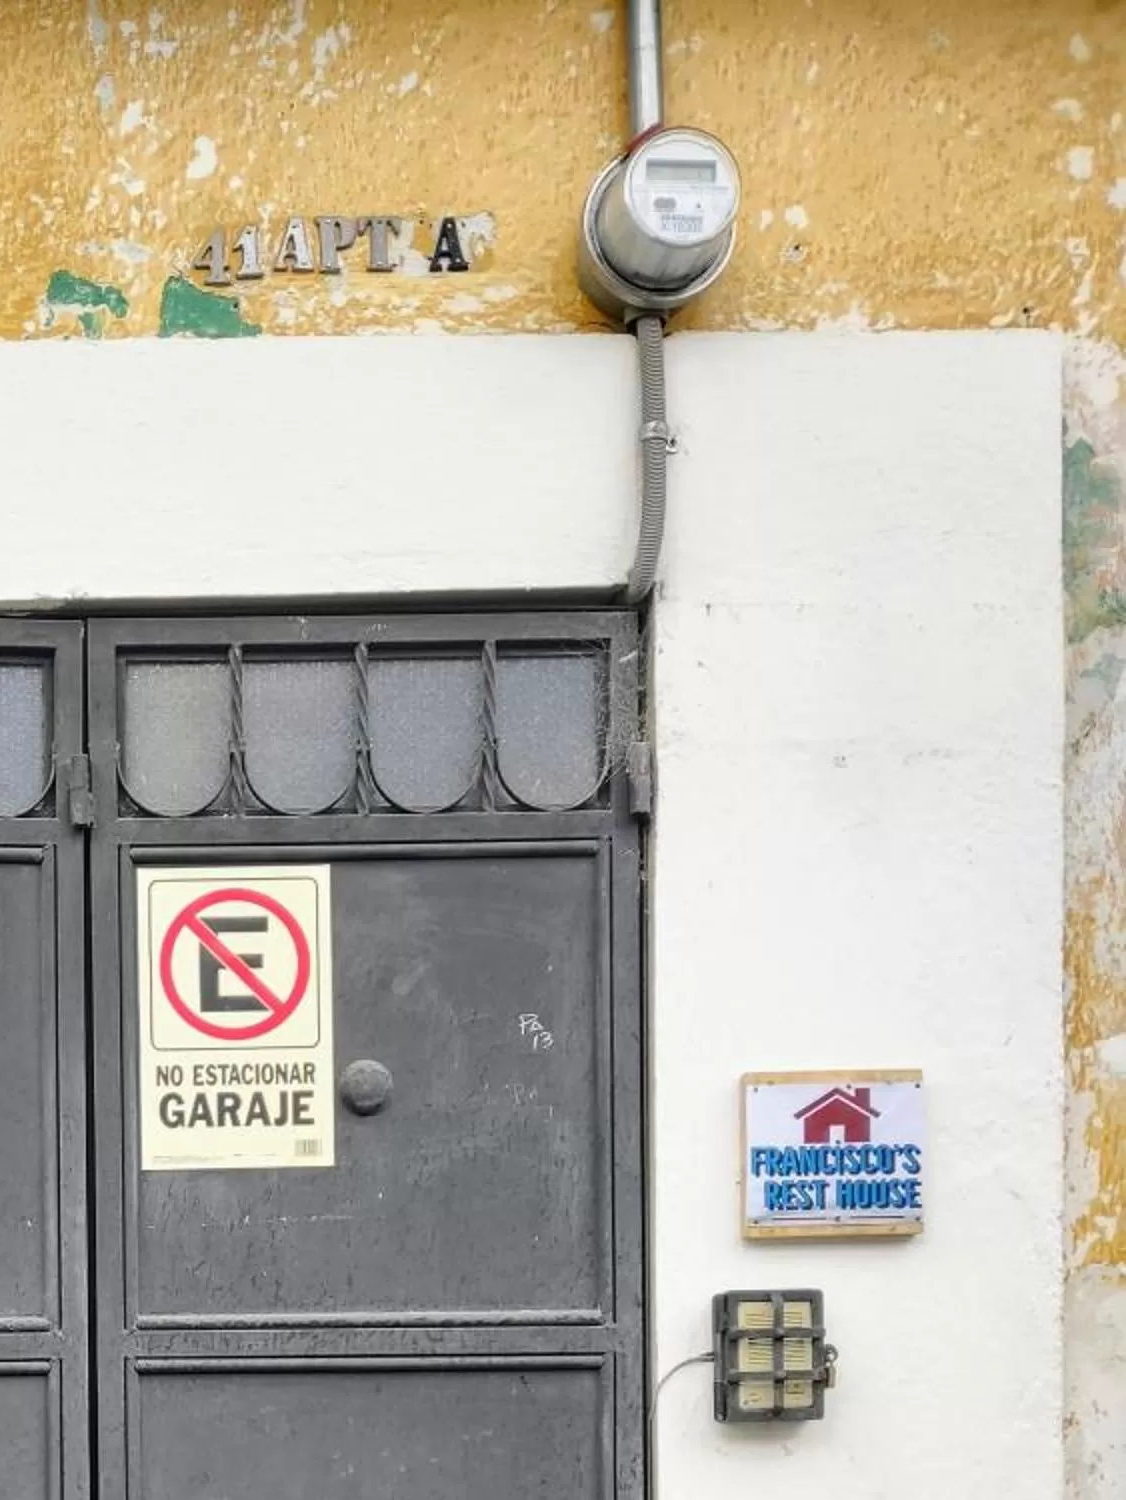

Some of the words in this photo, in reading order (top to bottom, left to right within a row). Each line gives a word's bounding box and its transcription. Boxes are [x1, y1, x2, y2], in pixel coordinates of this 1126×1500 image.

[428, 216, 471, 272] A
[155, 1064, 184, 1087] NO
[193, 1061, 317, 1087] ESTACIONAR
[159, 1090, 316, 1129] GARAJE
[750, 1143, 923, 1178] FRANCISCO'S
[764, 1179, 830, 1212] REST
[835, 1178, 923, 1210] HOUSE
